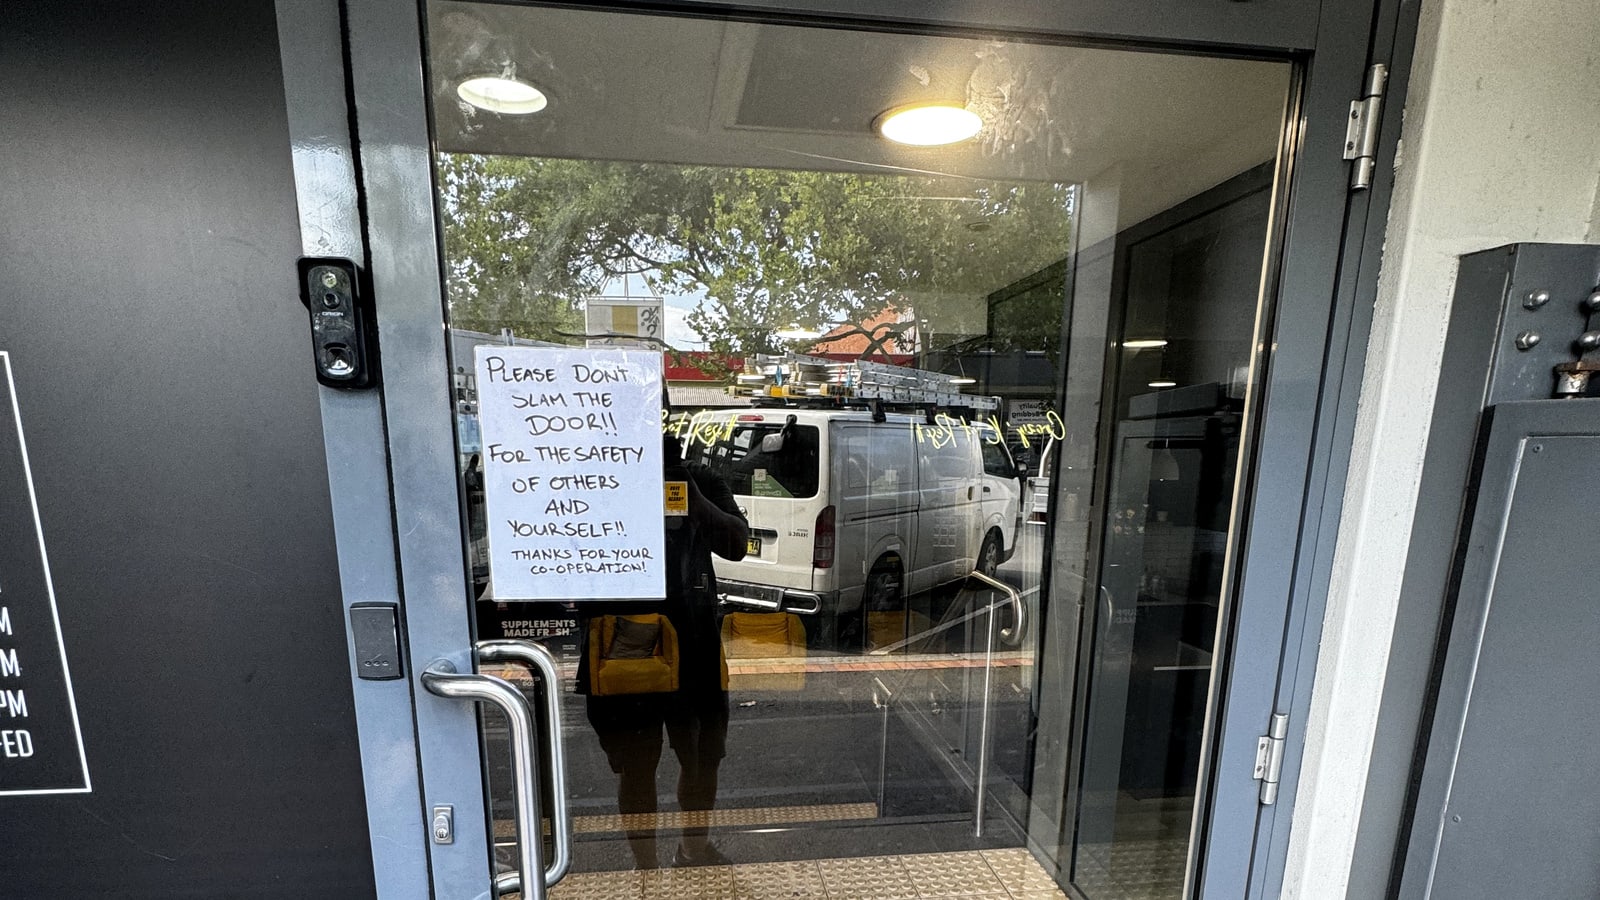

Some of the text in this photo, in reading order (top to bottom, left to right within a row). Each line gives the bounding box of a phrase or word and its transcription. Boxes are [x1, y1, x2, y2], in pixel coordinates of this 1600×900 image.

[486, 356, 556, 382] PLEASE
[512, 392, 612, 408] SLAM THE
[525, 412, 618, 436] DOOR!!
[488, 444, 644, 464] FOR THE SAFETY
[512, 475, 620, 493] OF OTHERS
[545, 499, 589, 517] AND
[507, 520, 628, 538] YOURSELF!!
[511, 547, 654, 561] THANKS FOR YOUR
[530, 561, 648, 575] CO-OPERATION!
[501, 619, 576, 629] SUPPLEMENTS
[504, 629, 535, 637] MADE
[0, 729, 34, 758] ED
